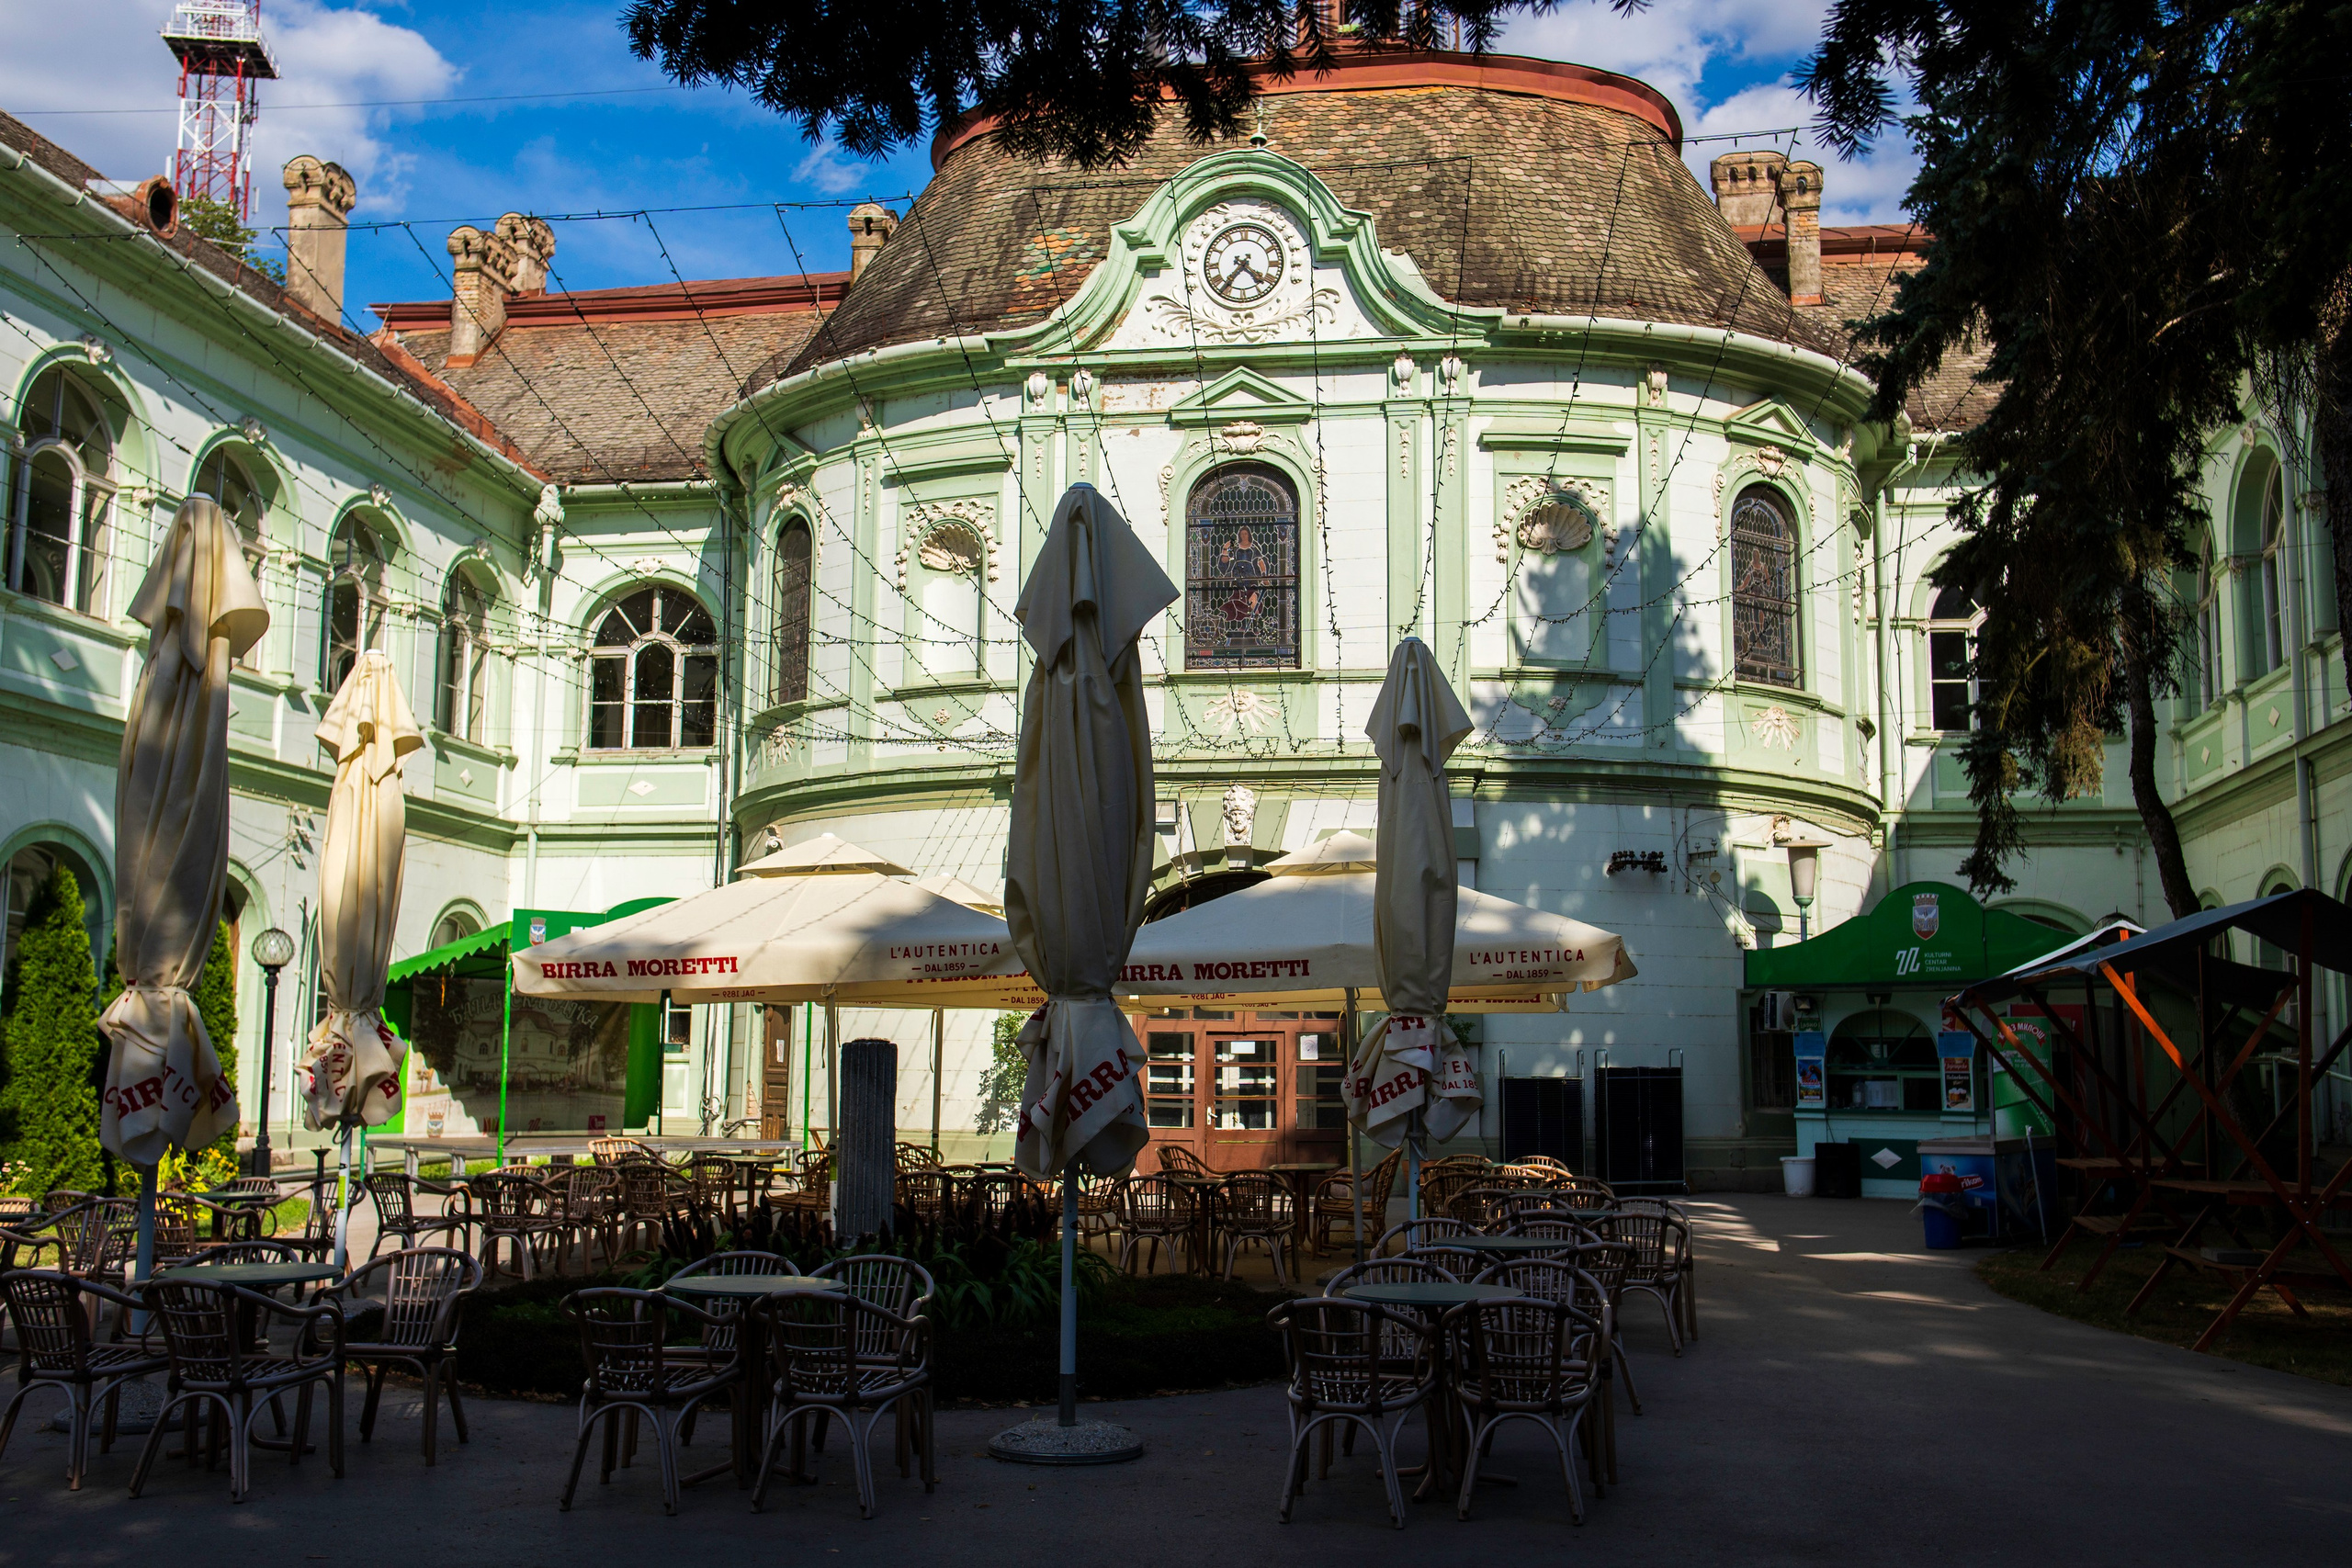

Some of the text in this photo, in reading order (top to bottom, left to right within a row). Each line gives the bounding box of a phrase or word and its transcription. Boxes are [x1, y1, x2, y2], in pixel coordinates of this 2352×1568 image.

[890, 942, 1001, 959] L'AUTENTICA
[1470, 949, 1585, 964] L'AUTENTICA
[540, 956, 738, 979] BIRRA MORETTI
[924, 963, 966, 973] DAL 1859
[1115, 960, 1309, 982] IRRA MORETTI
[1507, 969, 1549, 979] DAL 1859
[2018, 1022, 2046, 1040] МИЛОШ
[1065, 1048, 1130, 1130] IRRA
[1367, 1067, 1425, 1112] IRR
[117, 1076, 164, 1121] BIR
[1961, 1177, 1983, 1189] rikom
